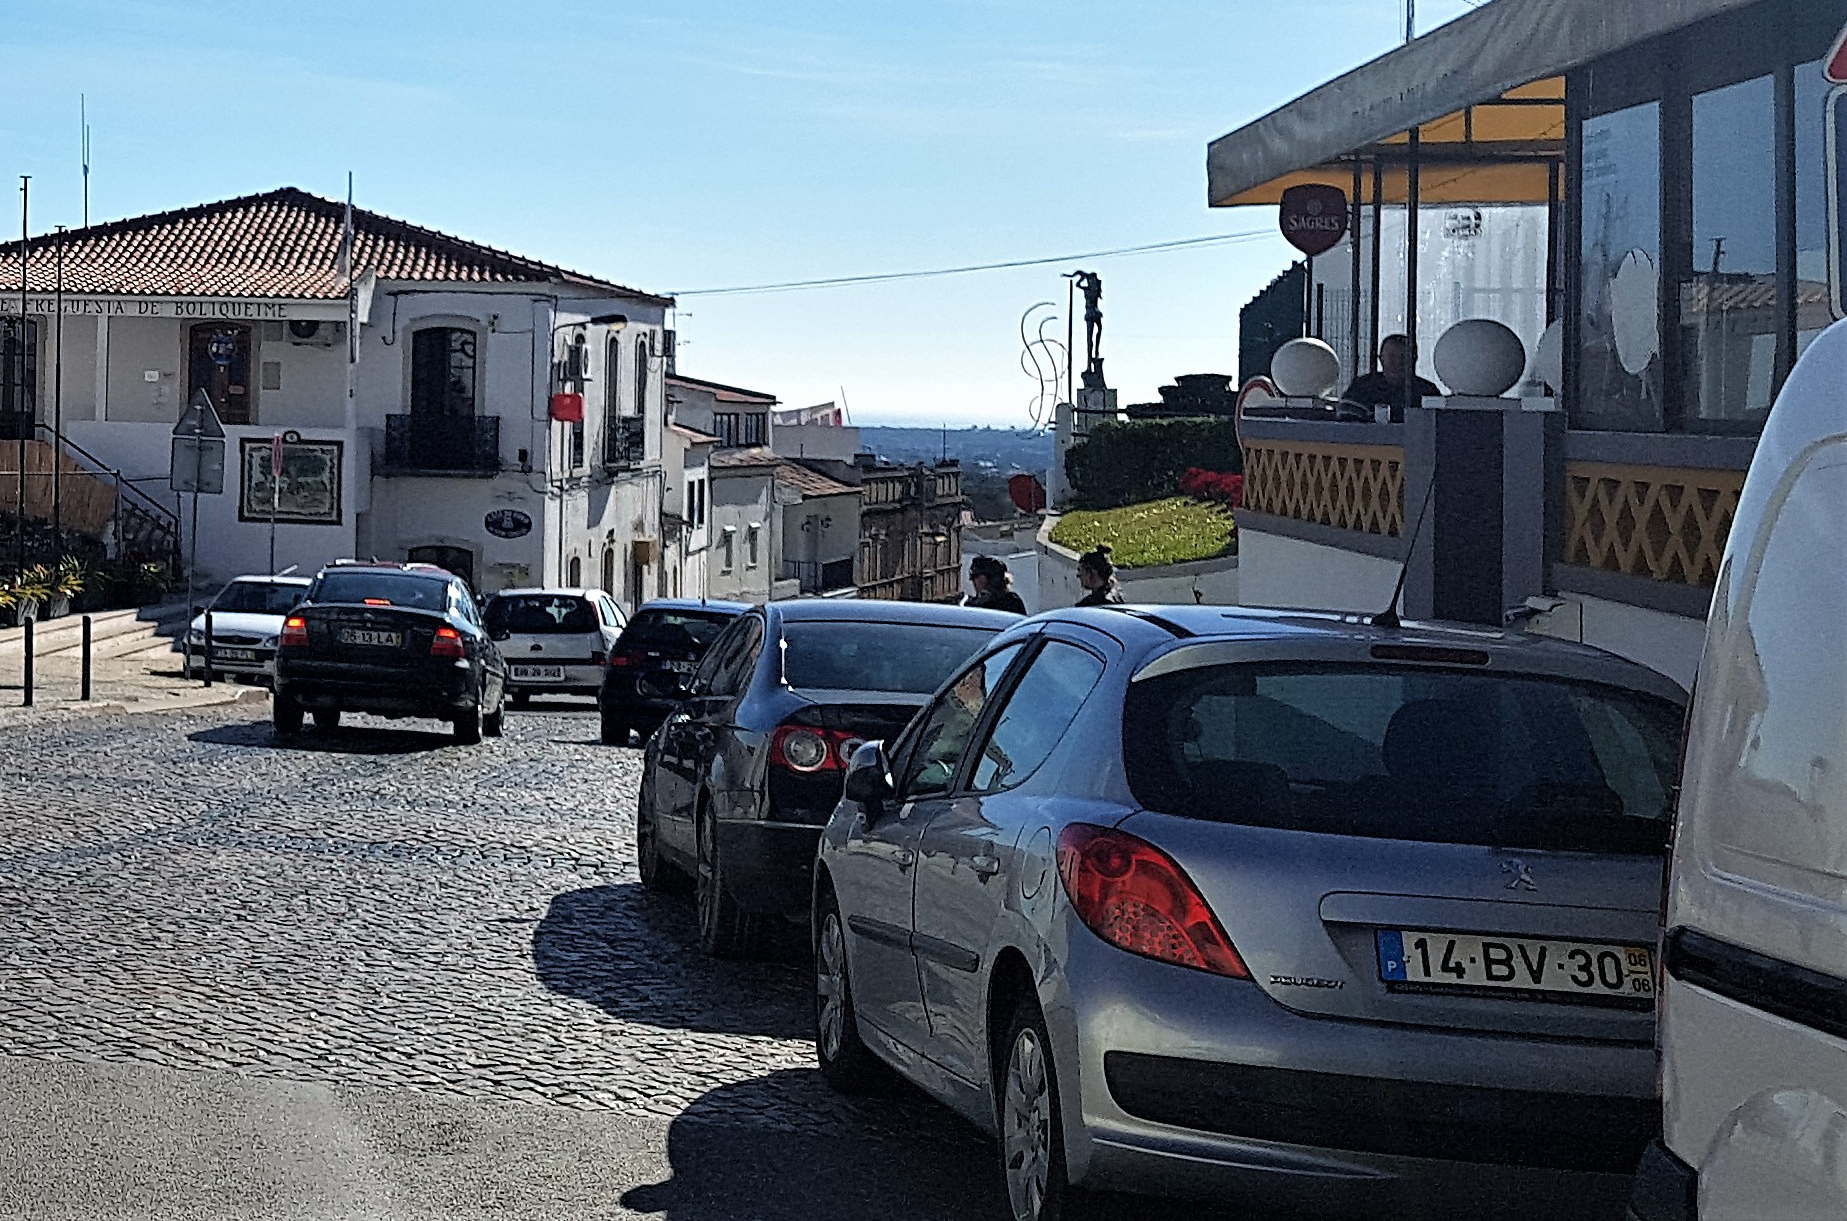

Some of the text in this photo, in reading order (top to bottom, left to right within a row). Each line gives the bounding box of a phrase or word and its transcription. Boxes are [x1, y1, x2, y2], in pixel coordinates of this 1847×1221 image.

[1288, 213, 1340, 233] SAGRES
[138, 300, 160, 315] DE
[175, 301, 287, 319] BOLIQUEIME
[1387, 960, 1397, 973] P
[1628, 952, 1647, 967] 06
